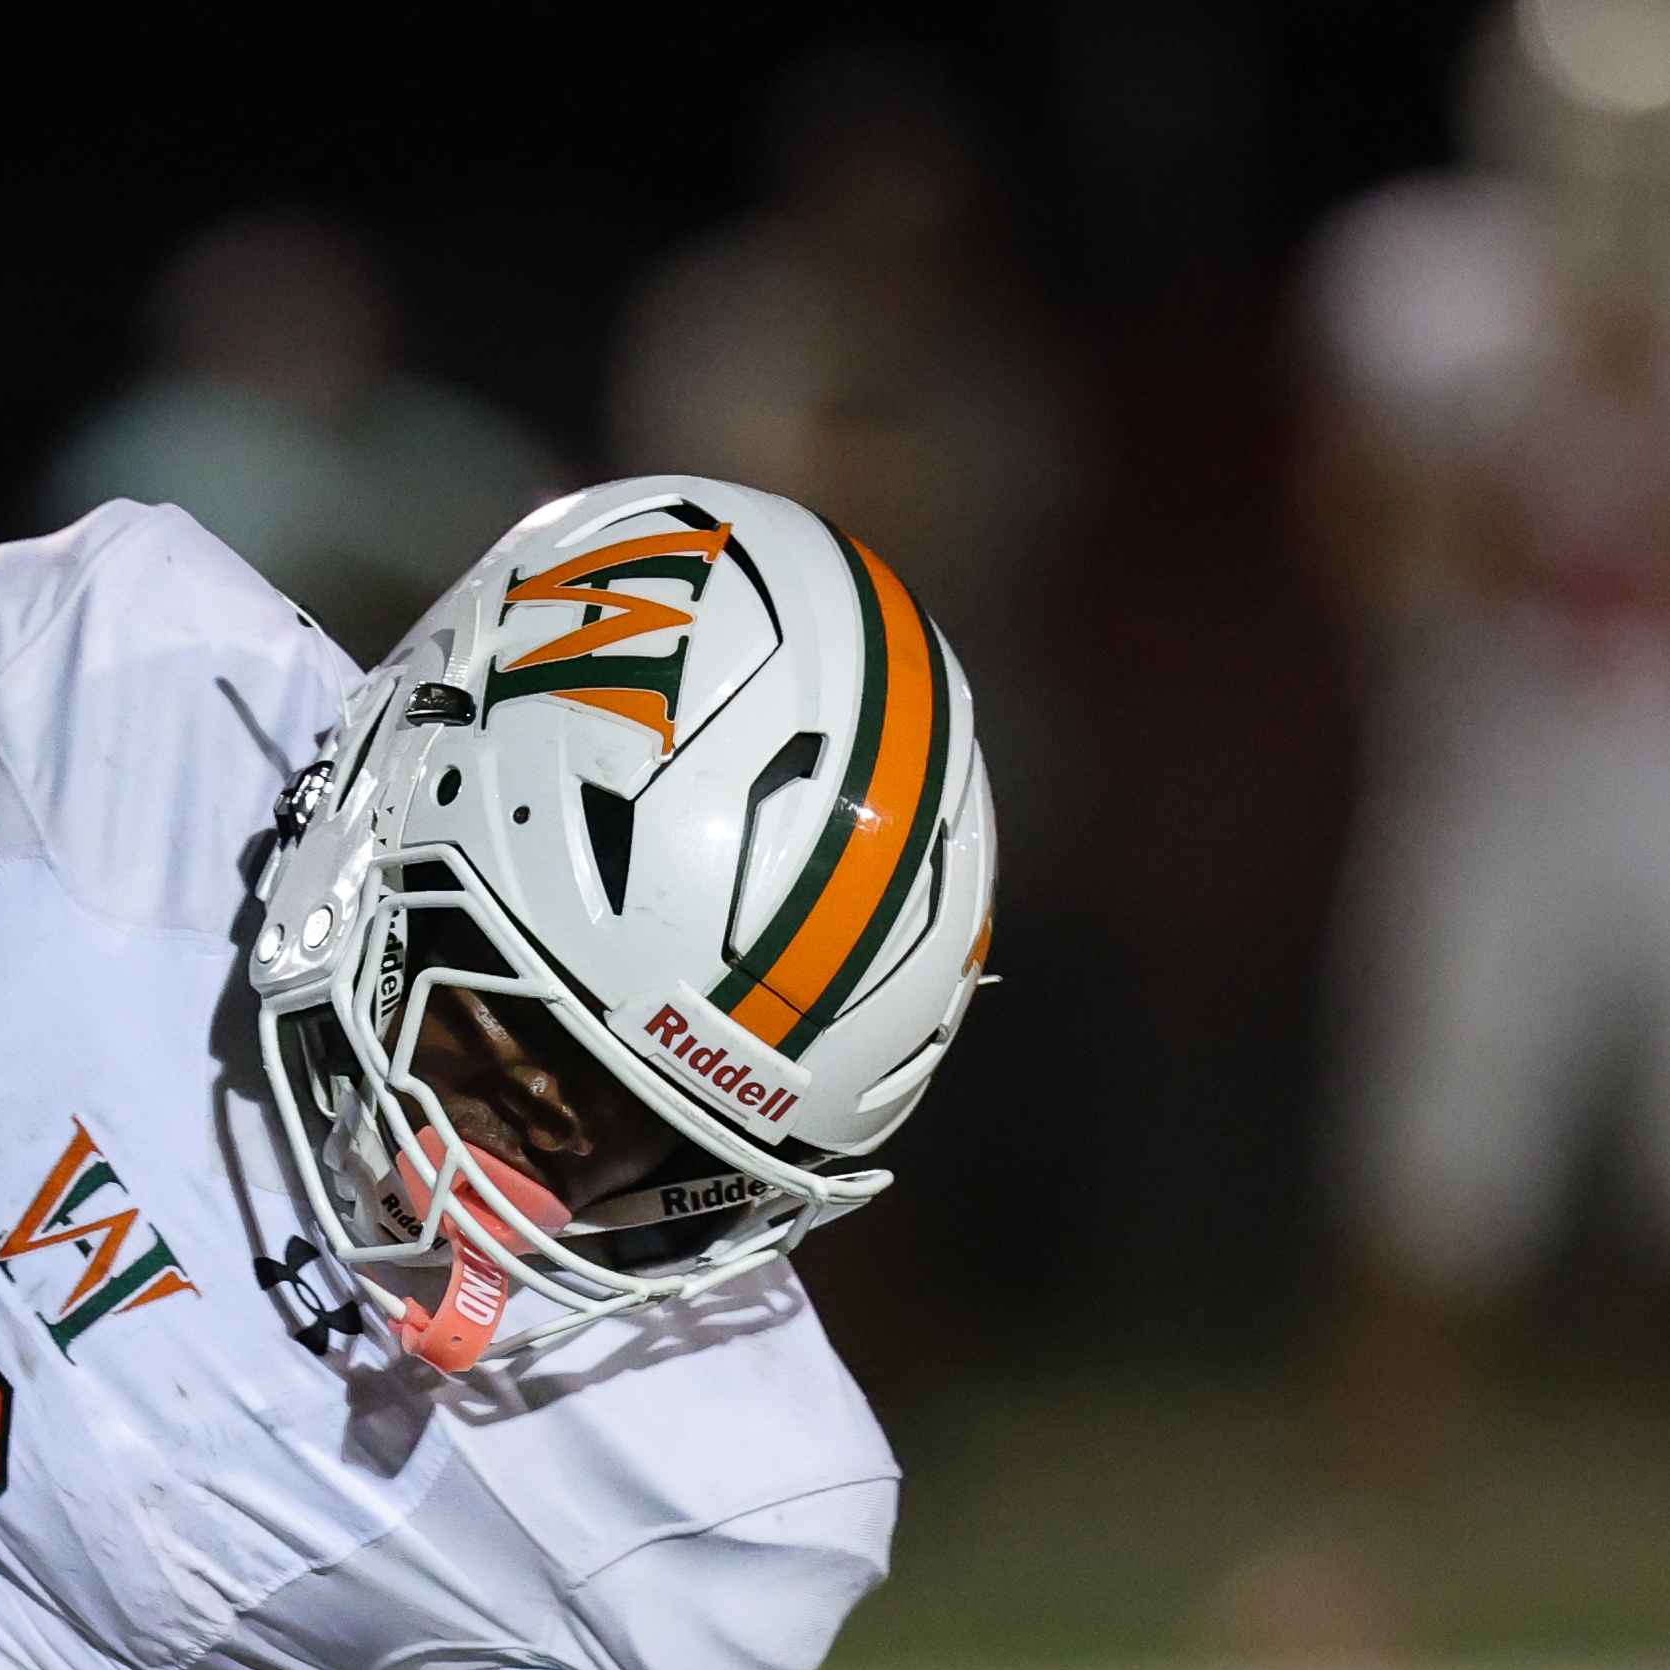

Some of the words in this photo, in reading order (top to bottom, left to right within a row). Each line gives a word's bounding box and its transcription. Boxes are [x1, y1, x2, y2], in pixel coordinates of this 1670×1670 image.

[380, 910, 404, 1018] ddell
[643, 1003, 800, 1123] Riddell
[381, 1192, 449, 1251] Riddll
[661, 1176, 768, 1216] Ridde
